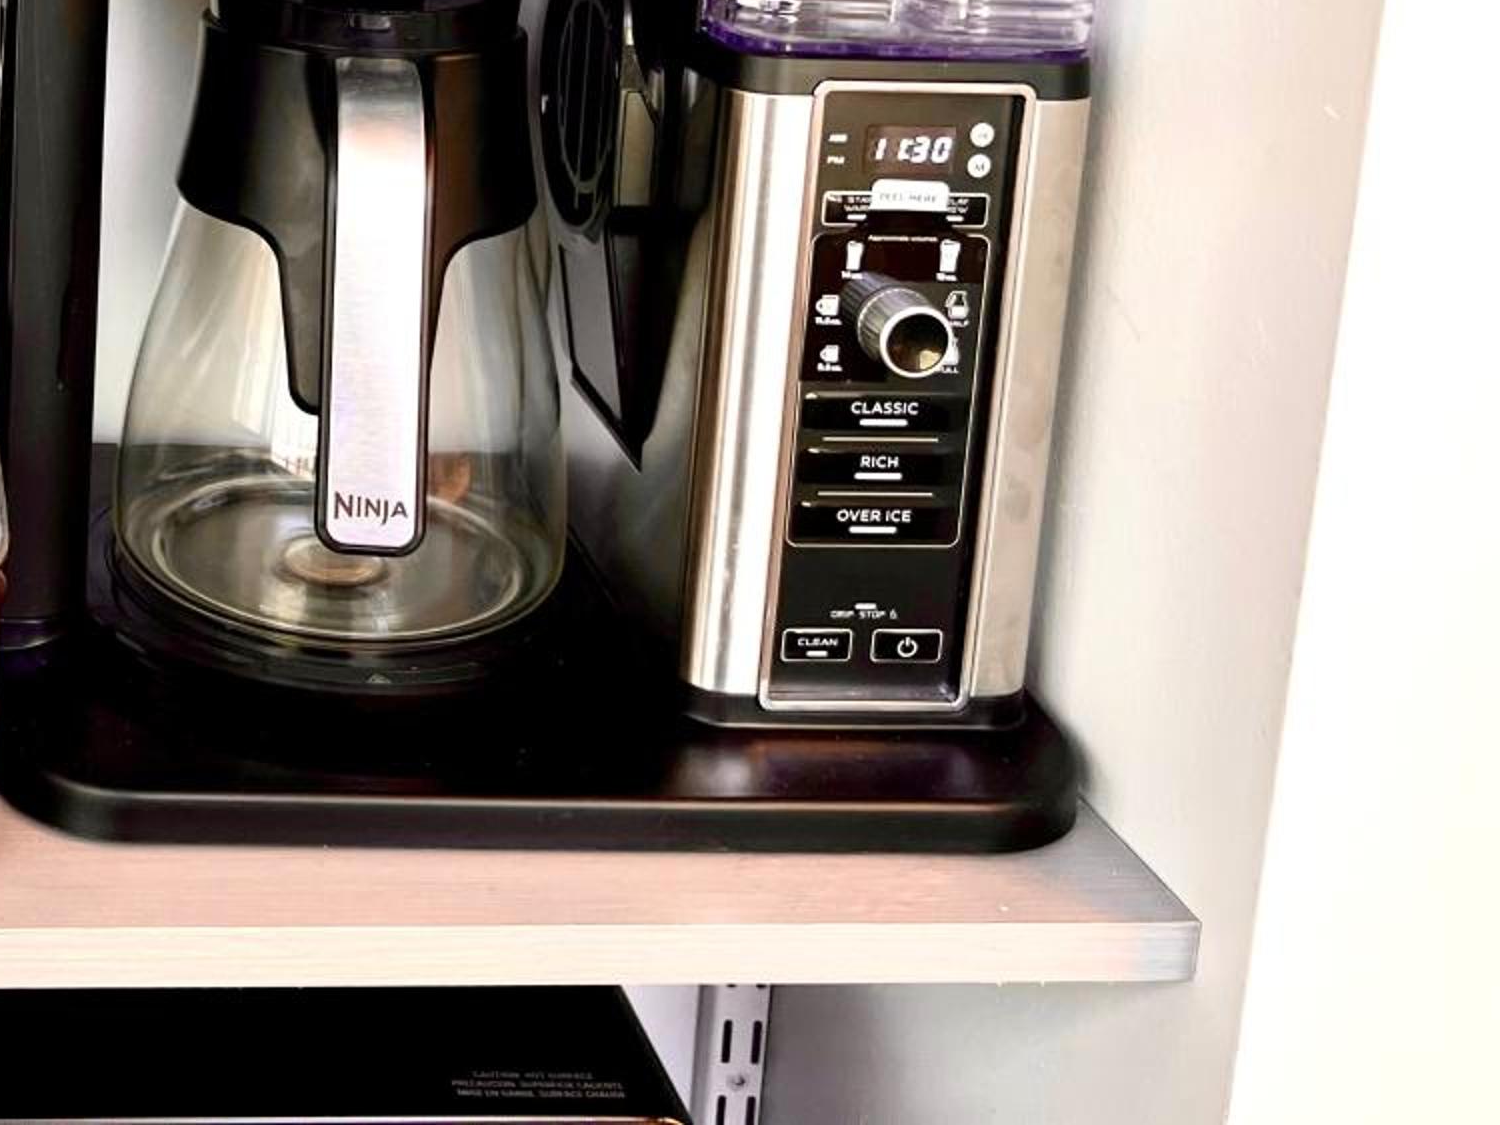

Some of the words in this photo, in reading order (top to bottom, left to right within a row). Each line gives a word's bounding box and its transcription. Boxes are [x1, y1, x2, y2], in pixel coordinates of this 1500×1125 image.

[850, 401, 919, 415] CLASSIC
[860, 455, 899, 468] RICH
[333, 491, 408, 525] NINJA
[836, 508, 881, 522] OVER
[885, 509, 912, 522] ICE
[797, 637, 839, 646] CLEAN
